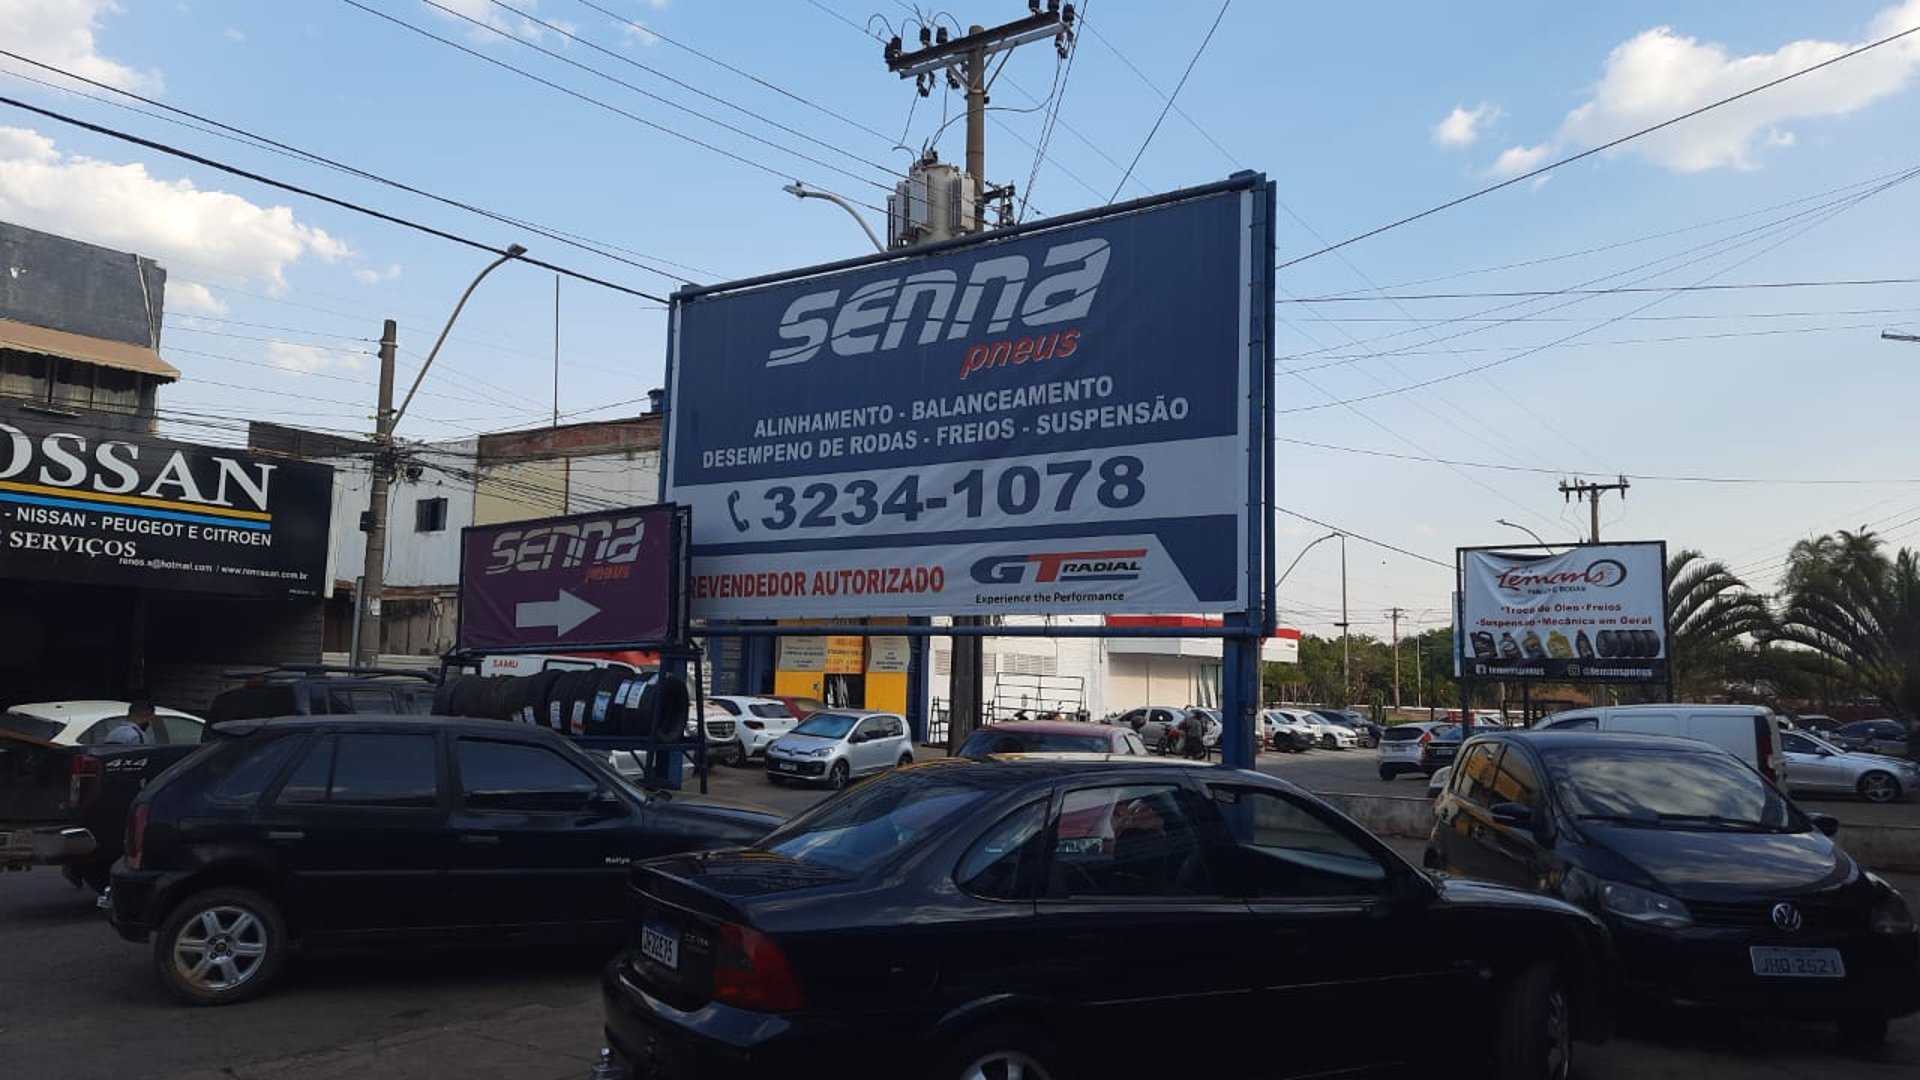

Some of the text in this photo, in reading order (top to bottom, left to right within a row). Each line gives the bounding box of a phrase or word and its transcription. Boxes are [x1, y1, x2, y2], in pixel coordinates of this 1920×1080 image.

[960, 328, 1080, 380] pneus
[754, 404, 893, 438] ALINHAMENTO
[912, 376, 1113, 421] BALANCEAMENTO
[702, 441, 813, 469] DESEMPENO
[818, 437, 844, 458] DE
[850, 430, 918, 454] RODAS
[936, 418, 1015, 446] FREIOS
[1036, 394, 1189, 436] SUSPENSÃO
[762, 455, 1146, 530] 3234-1078
[17, 506, 86, 528] NISSAN
[102, 517, 184, 539] PEUGEOT
[188, 526, 198, 539] E
[203, 527, 272, 547] CITROEN
[10, 530, 137, 558] SERVIÇOS
[812, 566, 945, 596] AUTORIZADO
[1063, 561, 1141, 573] RADIAL
[976, 592, 1125, 604] Experience the Performance
[1538, 604, 1551, 613] de
[1542, 614, 1595, 625] Mecânica
[1620, 615, 1652, 625] Geral
[106, 758, 148, 767] 4x4
